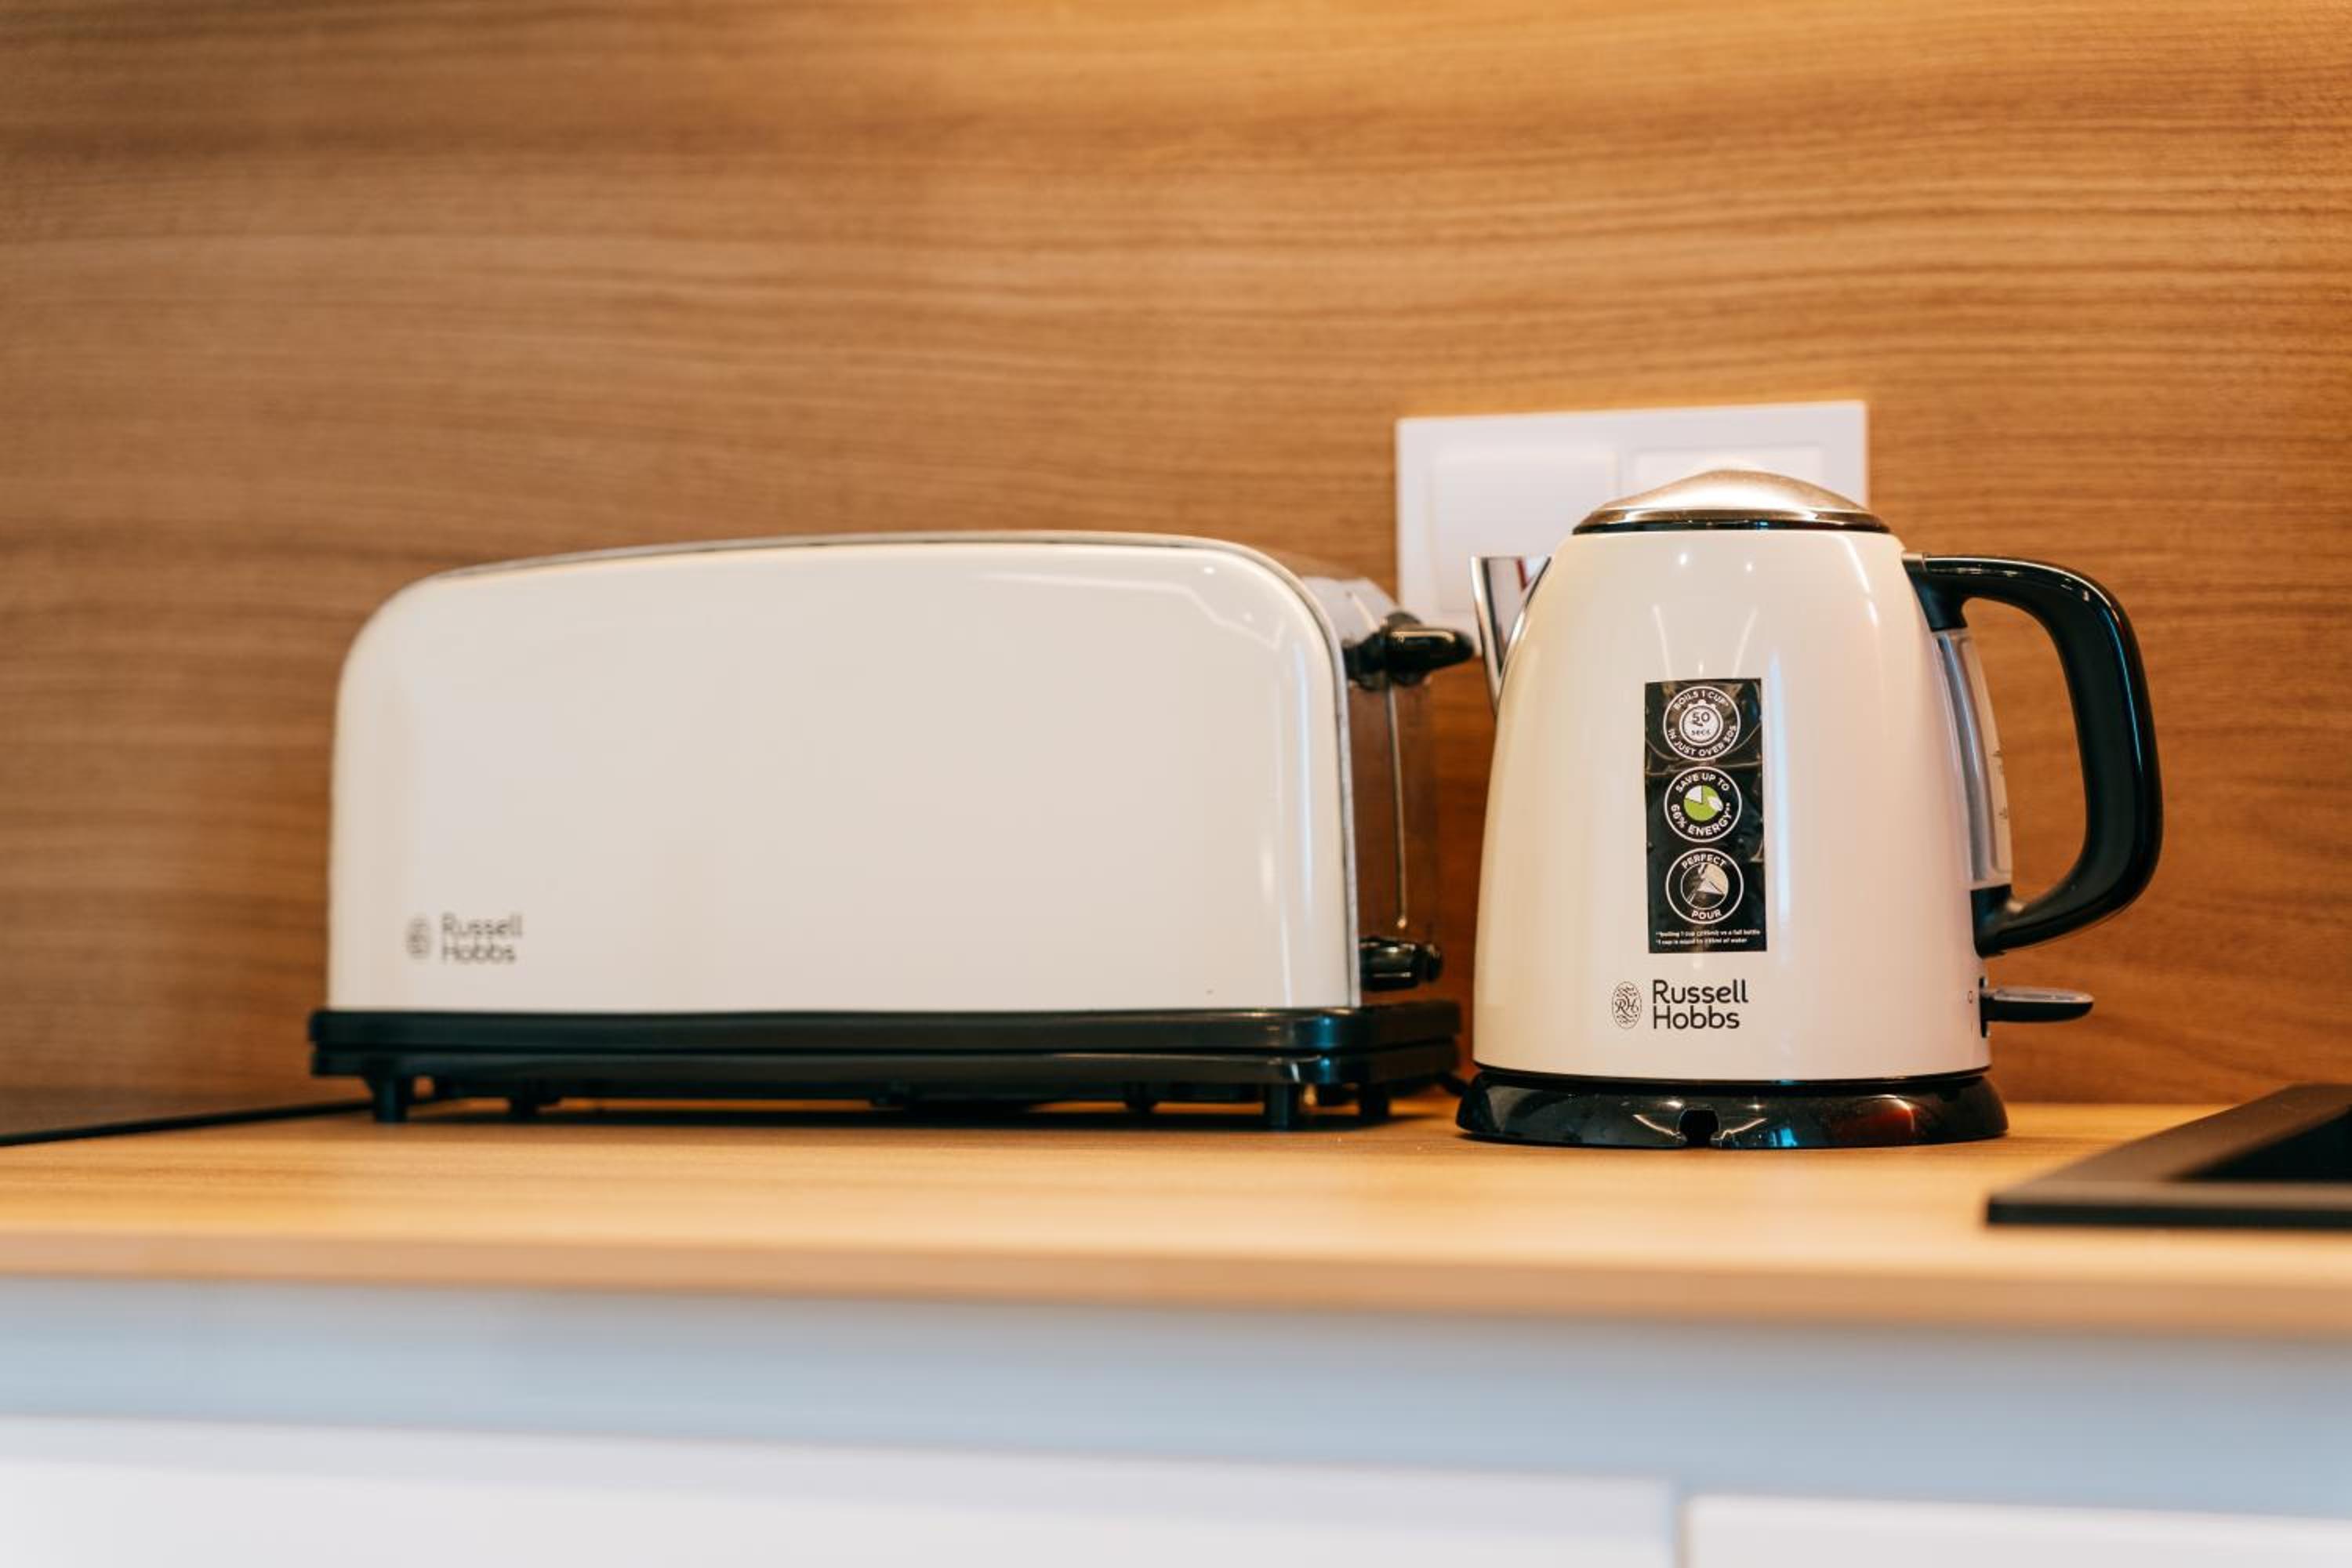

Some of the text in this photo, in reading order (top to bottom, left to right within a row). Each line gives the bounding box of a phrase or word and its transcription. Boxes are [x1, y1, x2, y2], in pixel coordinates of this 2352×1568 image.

[1673, 691, 1699, 710] BOILS
[1693, 711, 1710, 723] 50
[1668, 728, 1677, 739] IN
[1675, 740, 1695, 756] JUST
[1698, 742, 1725, 757] OVER
[1675, 772, 1730, 793] SAVE UP TO
[1671, 804, 1687, 828] 66%
[1682, 854, 1726, 869] PERFECT
[442, 912, 524, 937] Russell
[1691, 909, 1722, 920] POUR
[442, 939, 517, 964] Hobbs
[1653, 978, 1749, 1004] Russell
[1653, 1004, 1740, 1029] Hobbs
